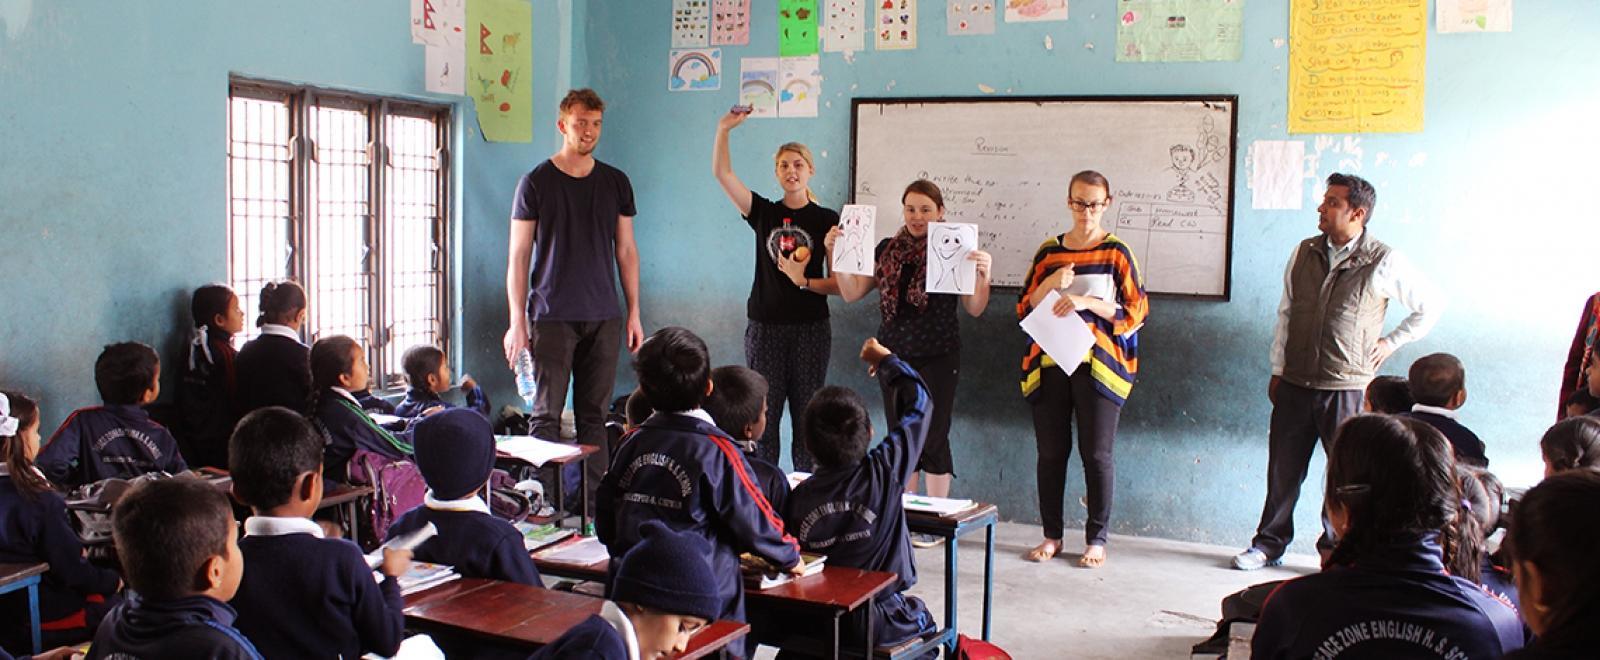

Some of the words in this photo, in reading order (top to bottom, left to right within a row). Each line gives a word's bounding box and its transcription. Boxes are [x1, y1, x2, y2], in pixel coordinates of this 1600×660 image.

[1336, 621, 1371, 648] ZONE
[1370, 620, 1423, 643] ENGLISH
[1421, 629, 1435, 649] H.
[1434, 636, 1448, 655] S.
